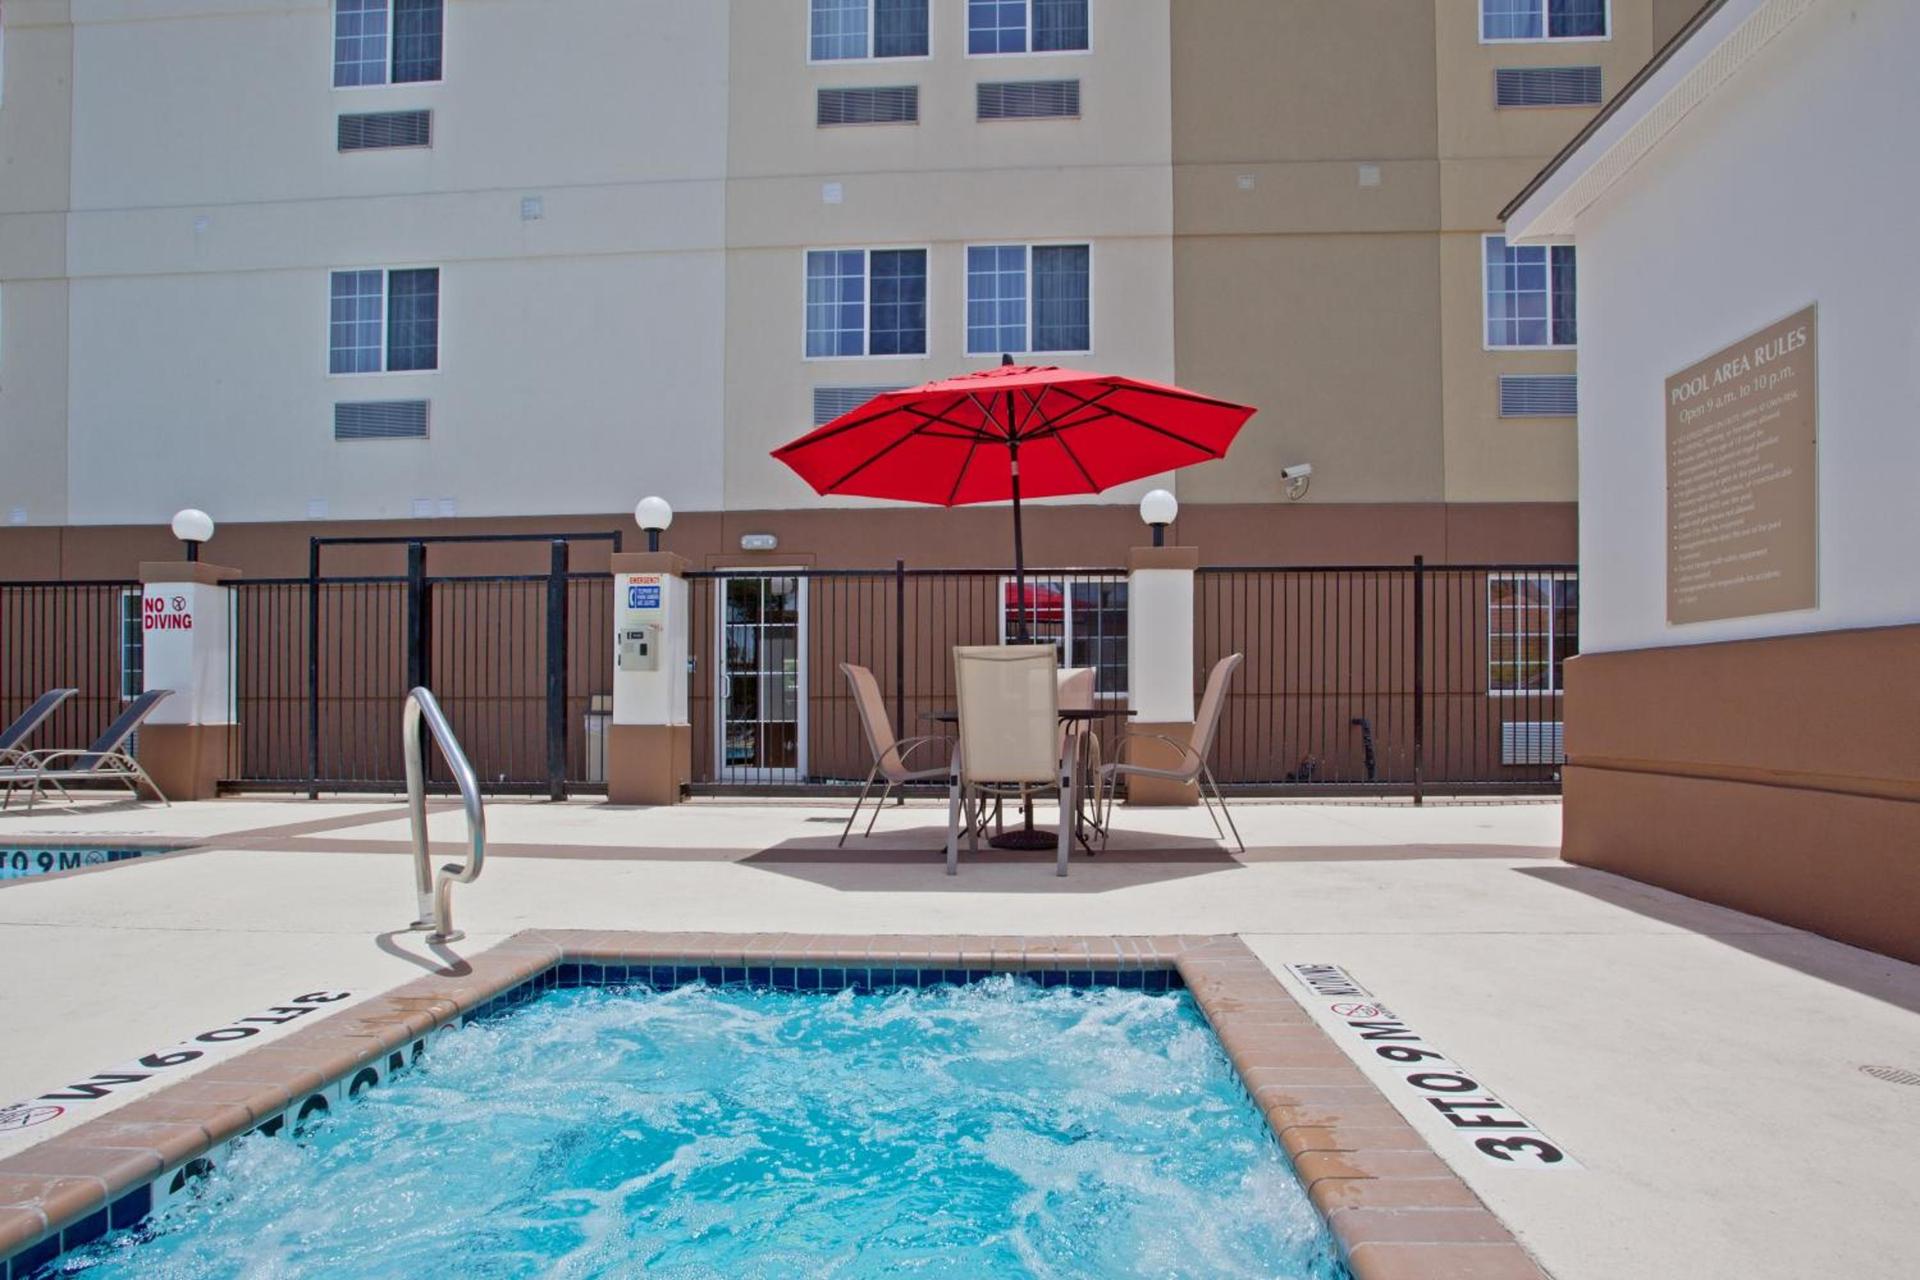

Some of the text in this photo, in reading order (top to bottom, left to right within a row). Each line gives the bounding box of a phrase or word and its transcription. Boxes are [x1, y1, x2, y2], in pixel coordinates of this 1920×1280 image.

[1671, 326, 1807, 405] POOL AREA RULES
[1680, 404, 1705, 424] Open
[1707, 398, 1714, 412] 9
[1754, 375, 1767, 391] 10
[1769, 366, 1795, 390] p.m.
[145, 597, 164, 613] NO
[145, 614, 192, 630] DIVING
